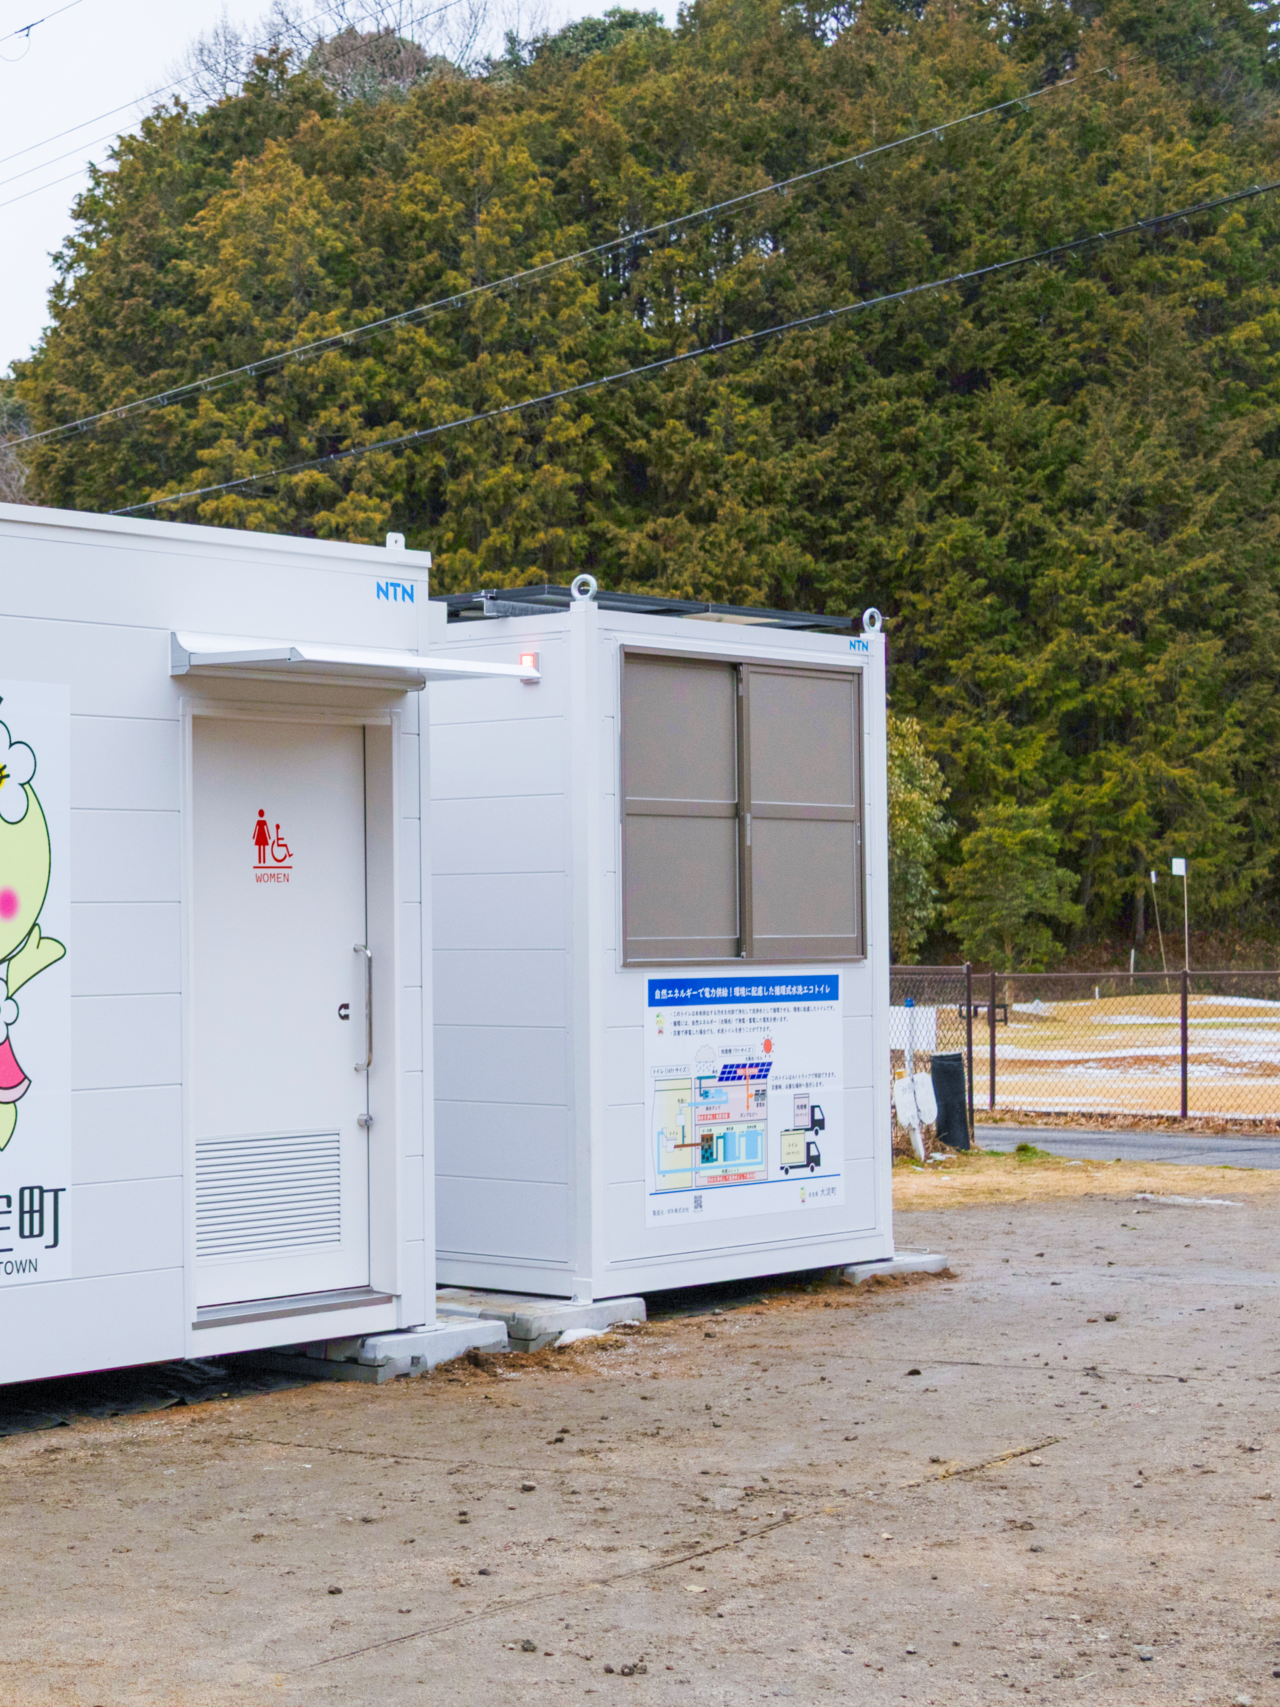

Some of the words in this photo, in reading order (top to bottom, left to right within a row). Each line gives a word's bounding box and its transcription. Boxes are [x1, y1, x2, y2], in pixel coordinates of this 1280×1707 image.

[376, 581, 414, 604] NTN
[849, 639, 869, 652] NTN
[255, 873, 290, 883] WOMEN
